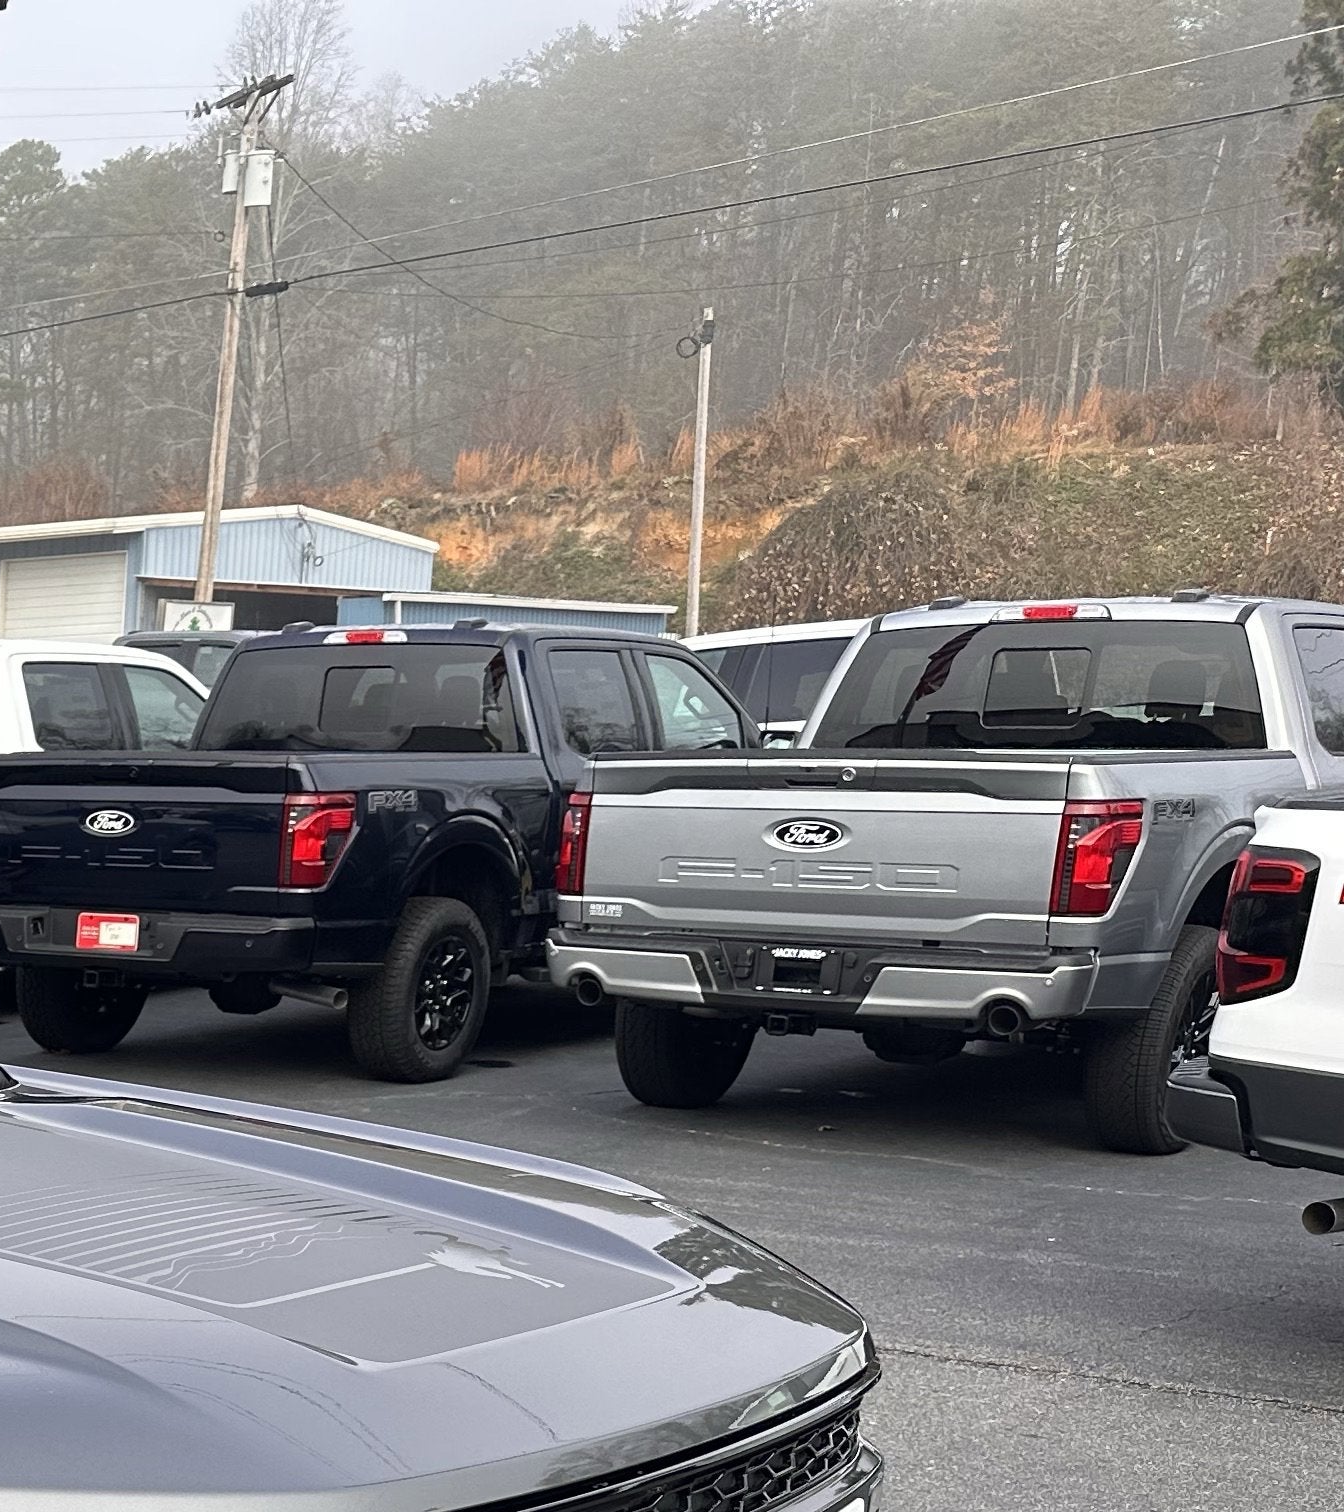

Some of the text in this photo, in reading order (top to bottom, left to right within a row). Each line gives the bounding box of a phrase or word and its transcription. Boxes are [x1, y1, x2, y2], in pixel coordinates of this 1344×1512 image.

[368, 790, 417, 814] FX4
[1152, 798, 1196, 825] FX4
[783, 824, 829, 844] Ford
[658, 855, 960, 894] F-150
